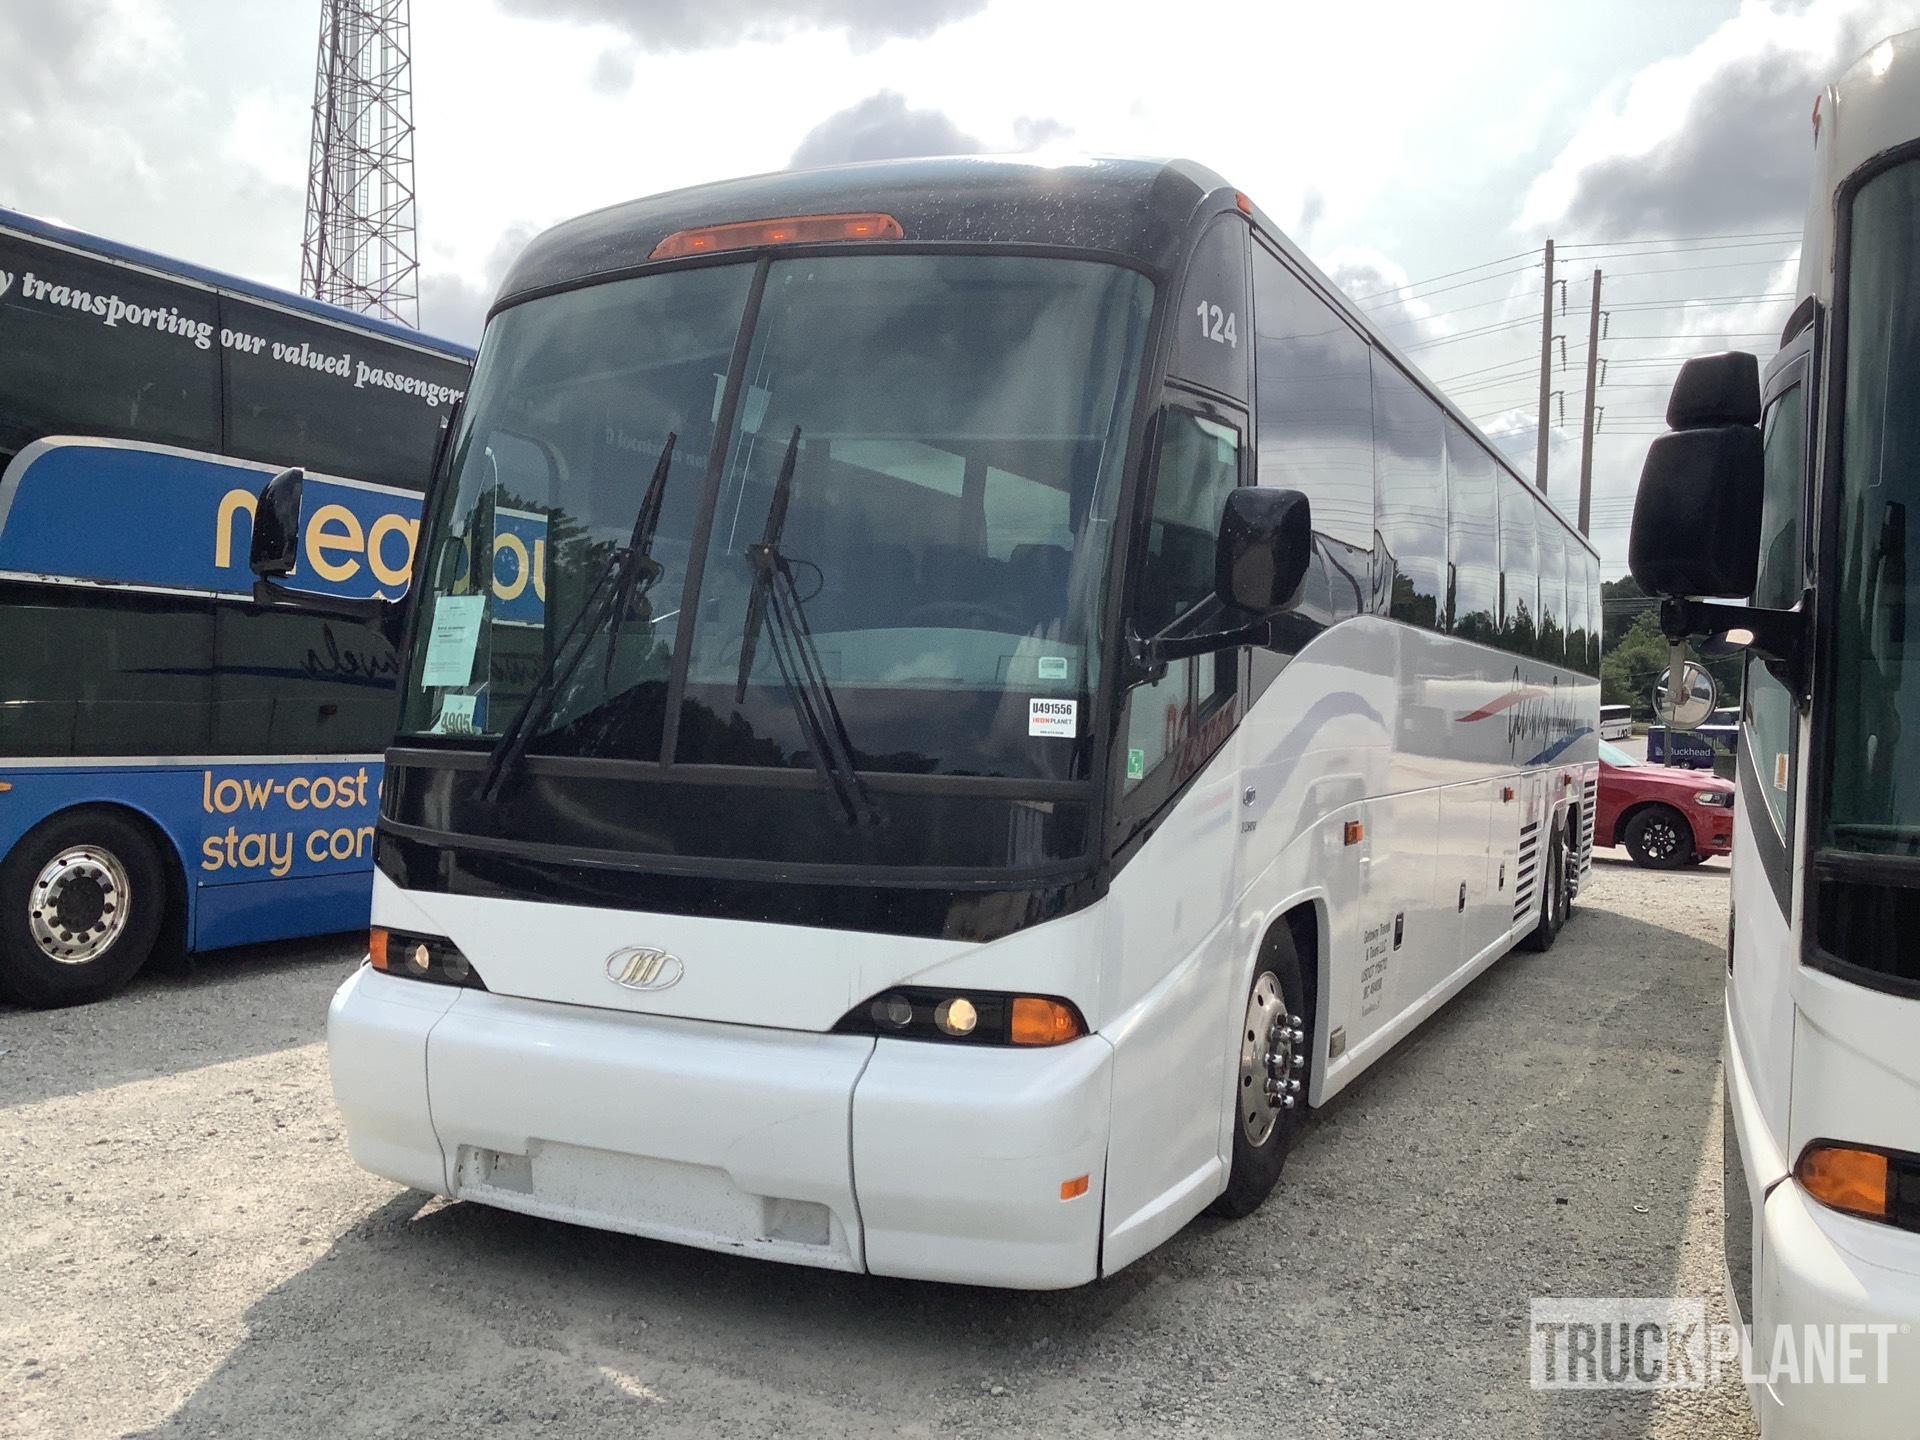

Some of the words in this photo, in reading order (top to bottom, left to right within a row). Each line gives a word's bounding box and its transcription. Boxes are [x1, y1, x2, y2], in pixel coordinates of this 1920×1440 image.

[22, 271, 213, 350] transporting
[219, 326, 267, 355] our
[271, 341, 351, 378] valued
[1196, 300, 1237, 349] 124
[1032, 703, 1072, 715] U491556
[203, 767, 369, 814] low-cost
[202, 826, 293, 876] stay
